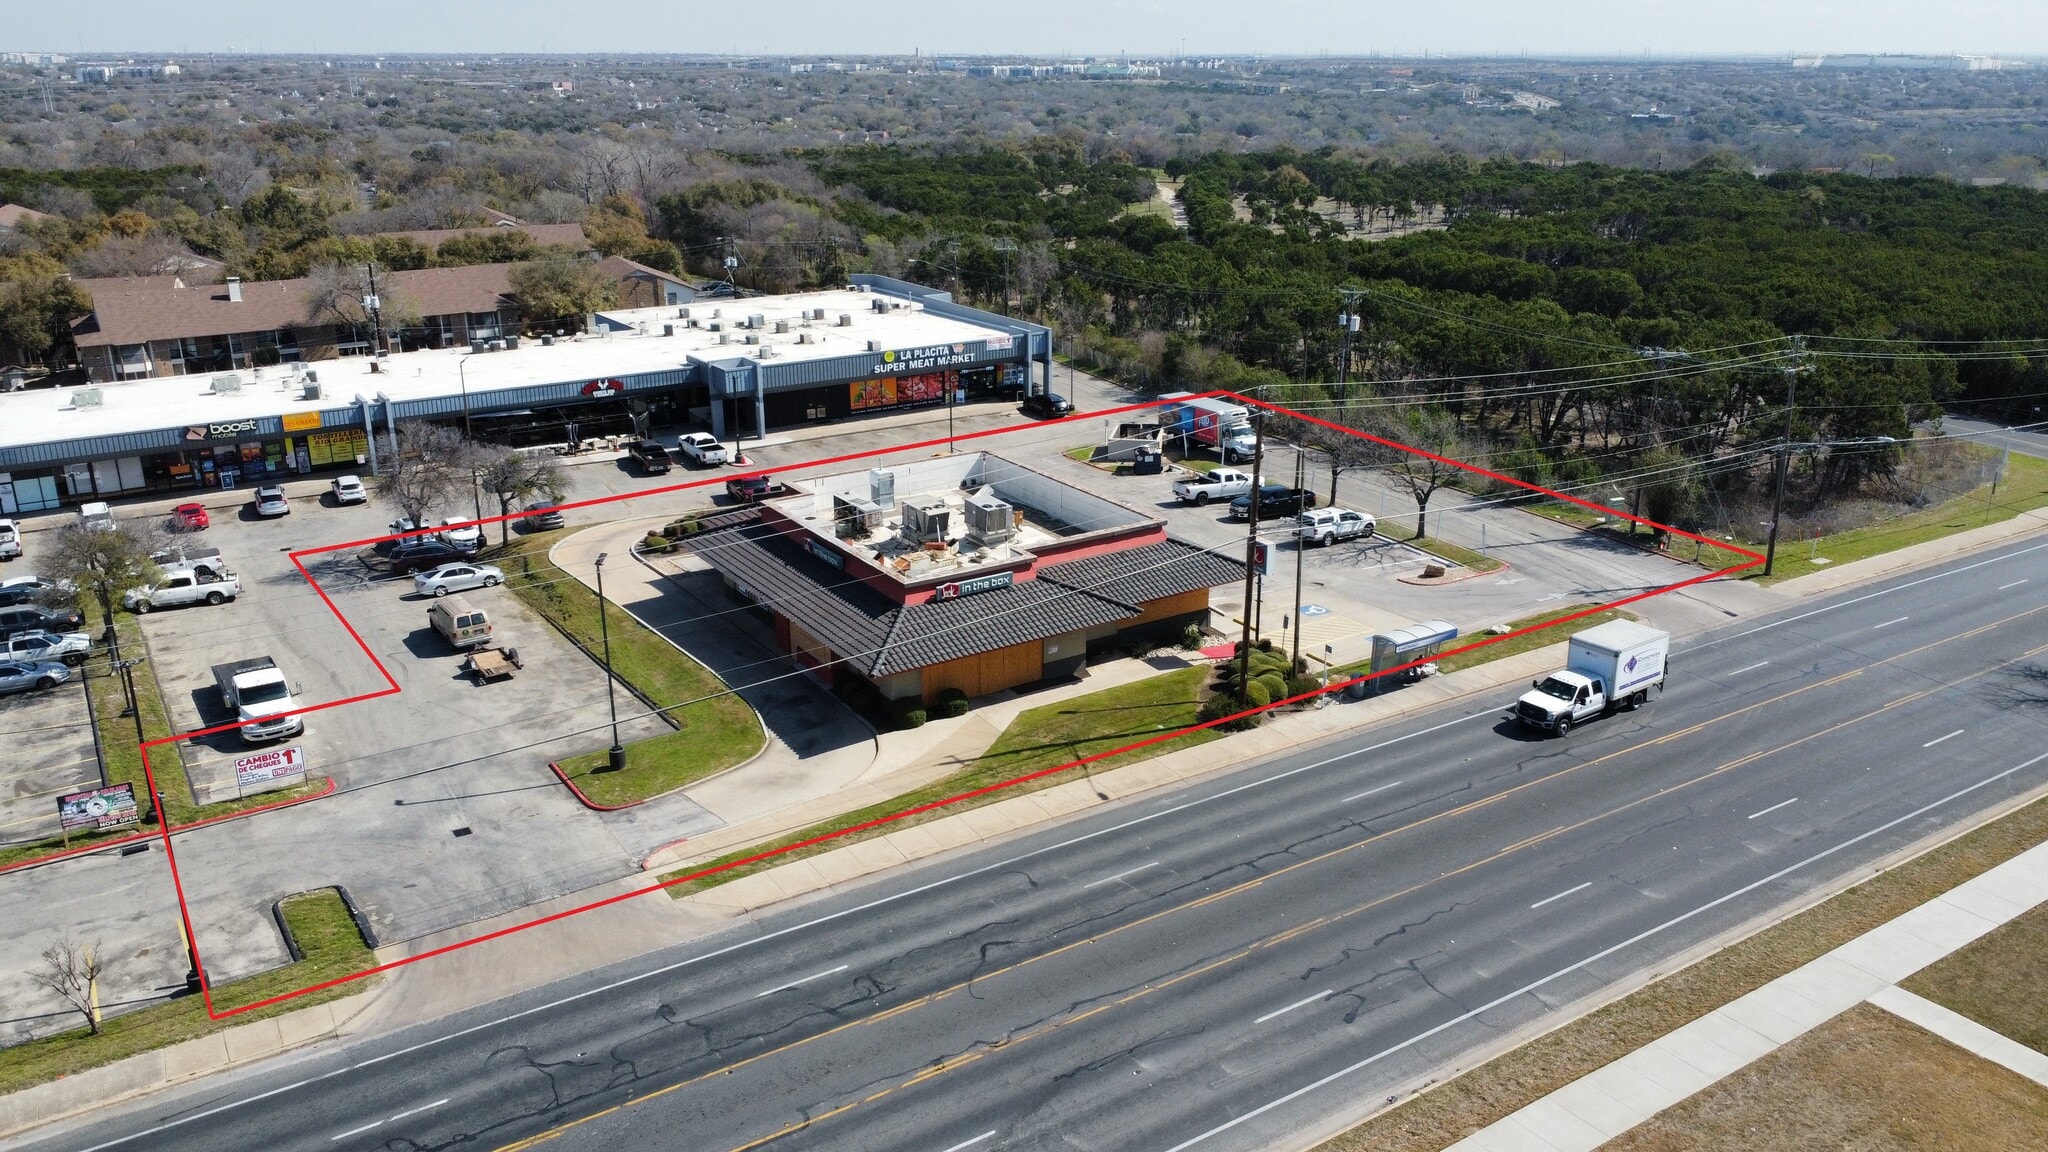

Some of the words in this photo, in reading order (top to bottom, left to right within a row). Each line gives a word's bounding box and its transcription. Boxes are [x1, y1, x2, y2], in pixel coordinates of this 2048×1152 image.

[900, 350, 912, 361] LA
[913, 346, 949, 359] PLACITA
[874, 362, 906, 374] SUPER
[908, 358, 935, 370] MEAT
[937, 353, 975, 366] MARKET
[210, 419, 256, 434] boost
[312, 429, 365, 440] TORTILLERI
[315, 438, 330, 446] RIO
[942, 585, 957, 599] Jack
[961, 584, 971, 593] in
[973, 581, 990, 591] the
[991, 577, 1010, 587] box
[237, 752, 280, 767] CAMBIO
[249, 759, 281, 771] CHEQUES
[99, 819, 118, 828] NOW
[119, 814, 139, 823] OPEN
